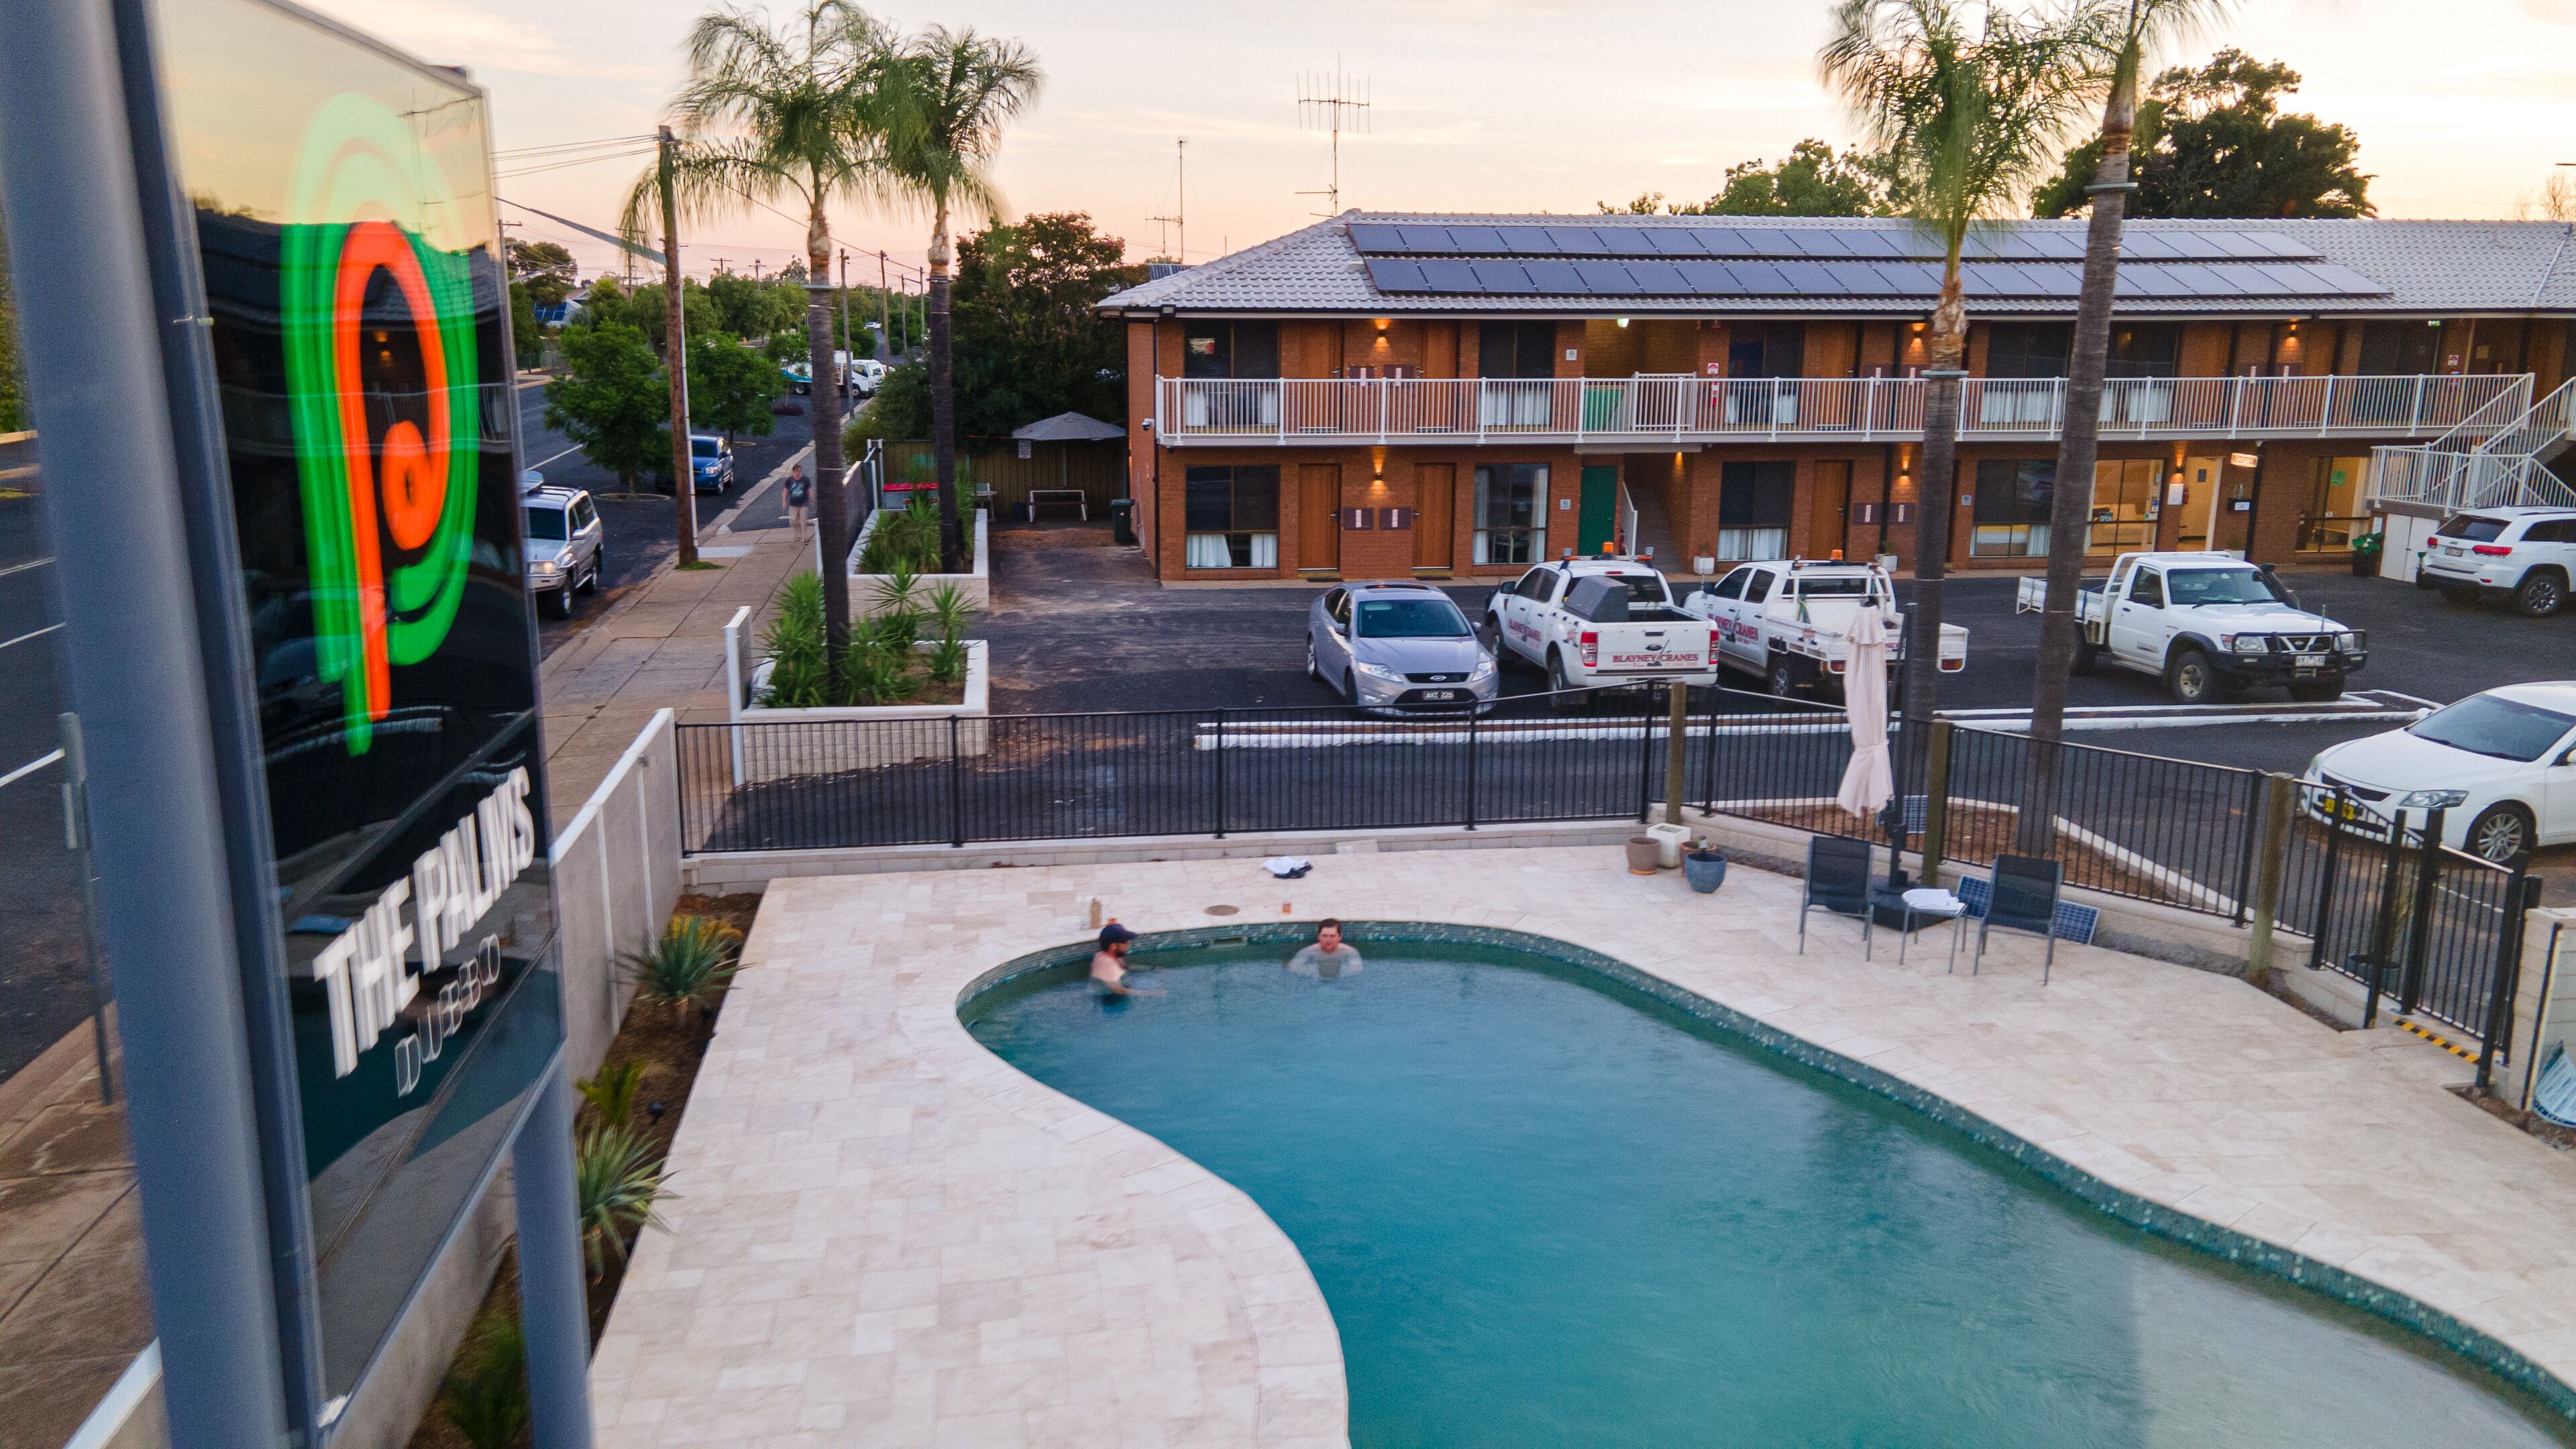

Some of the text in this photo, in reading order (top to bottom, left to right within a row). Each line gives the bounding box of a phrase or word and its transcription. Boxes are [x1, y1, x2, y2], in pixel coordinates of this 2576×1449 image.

[1613, 653, 1699, 663] BLAYNEY CRANES
[313, 765, 535, 1079] THE PALMS
[395, 933, 500, 1098] DUBBO
